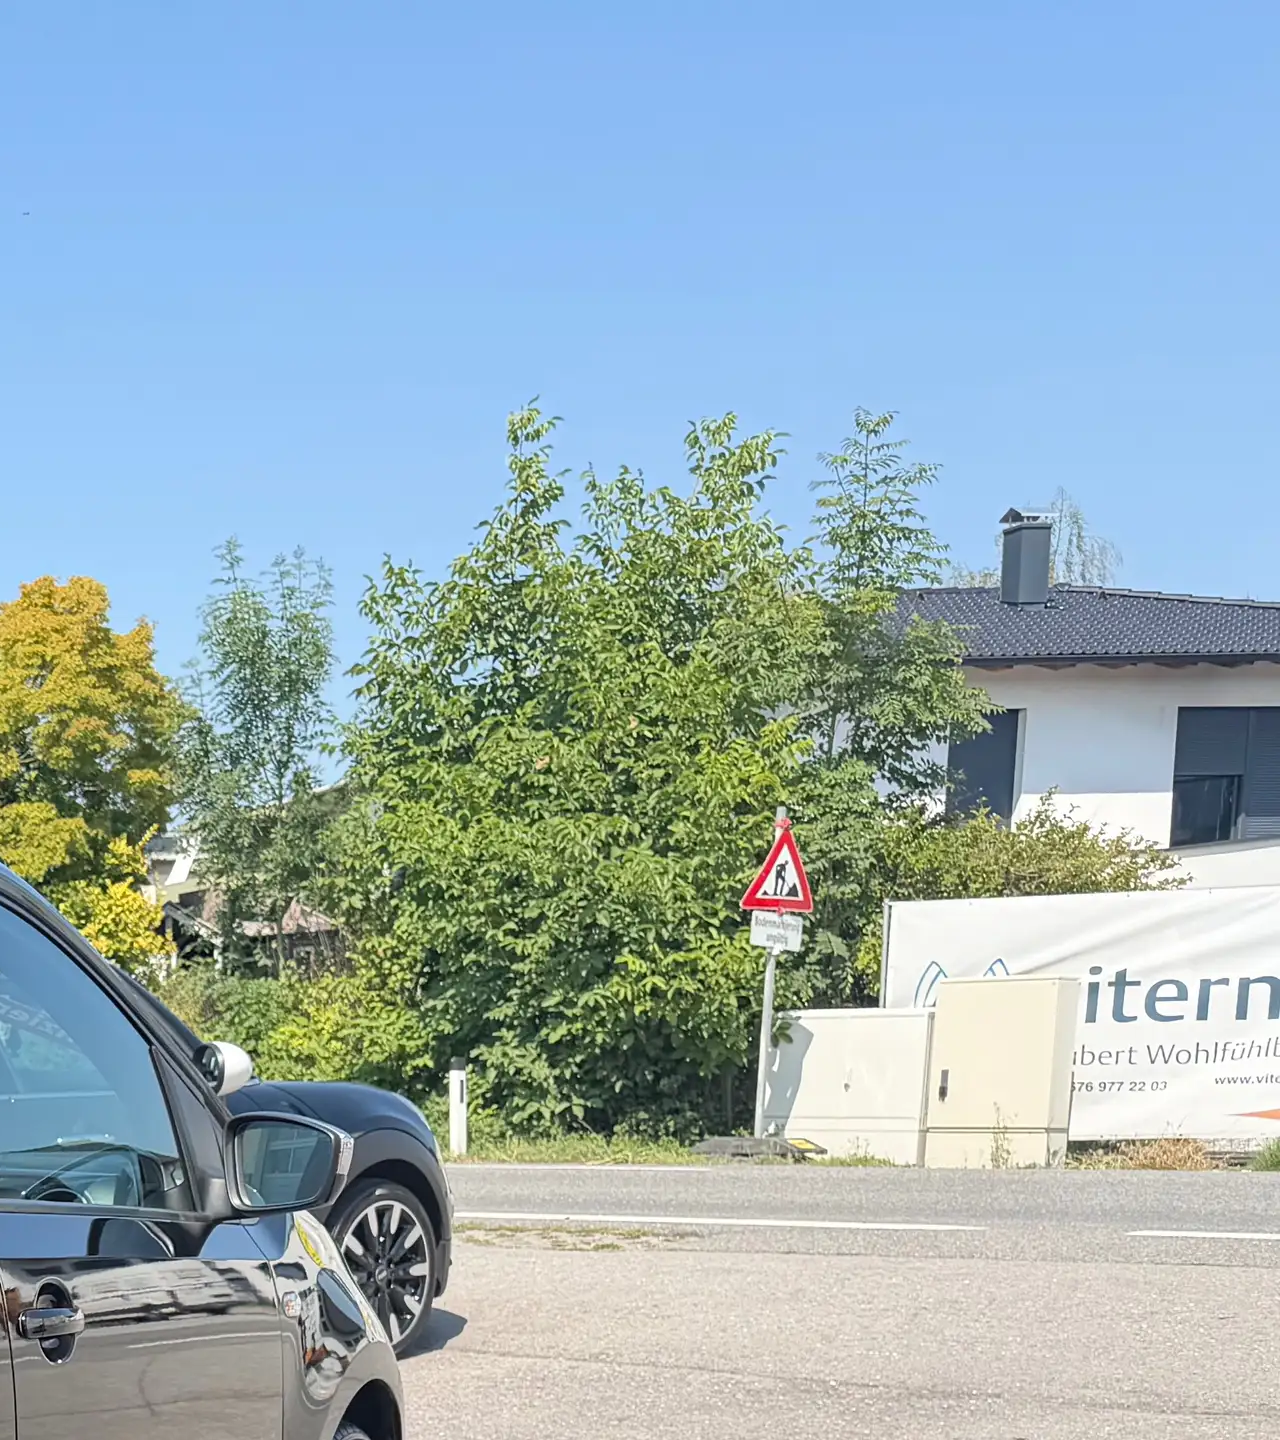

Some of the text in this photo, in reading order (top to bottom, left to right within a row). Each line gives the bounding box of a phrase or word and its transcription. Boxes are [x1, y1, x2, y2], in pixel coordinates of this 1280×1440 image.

[1072, 1045, 1138, 1066] bert
[1098, 1081, 1124, 1092] 977
[1129, 1081, 1146, 1092] 22
[1151, 1081, 1167, 1092] 03
